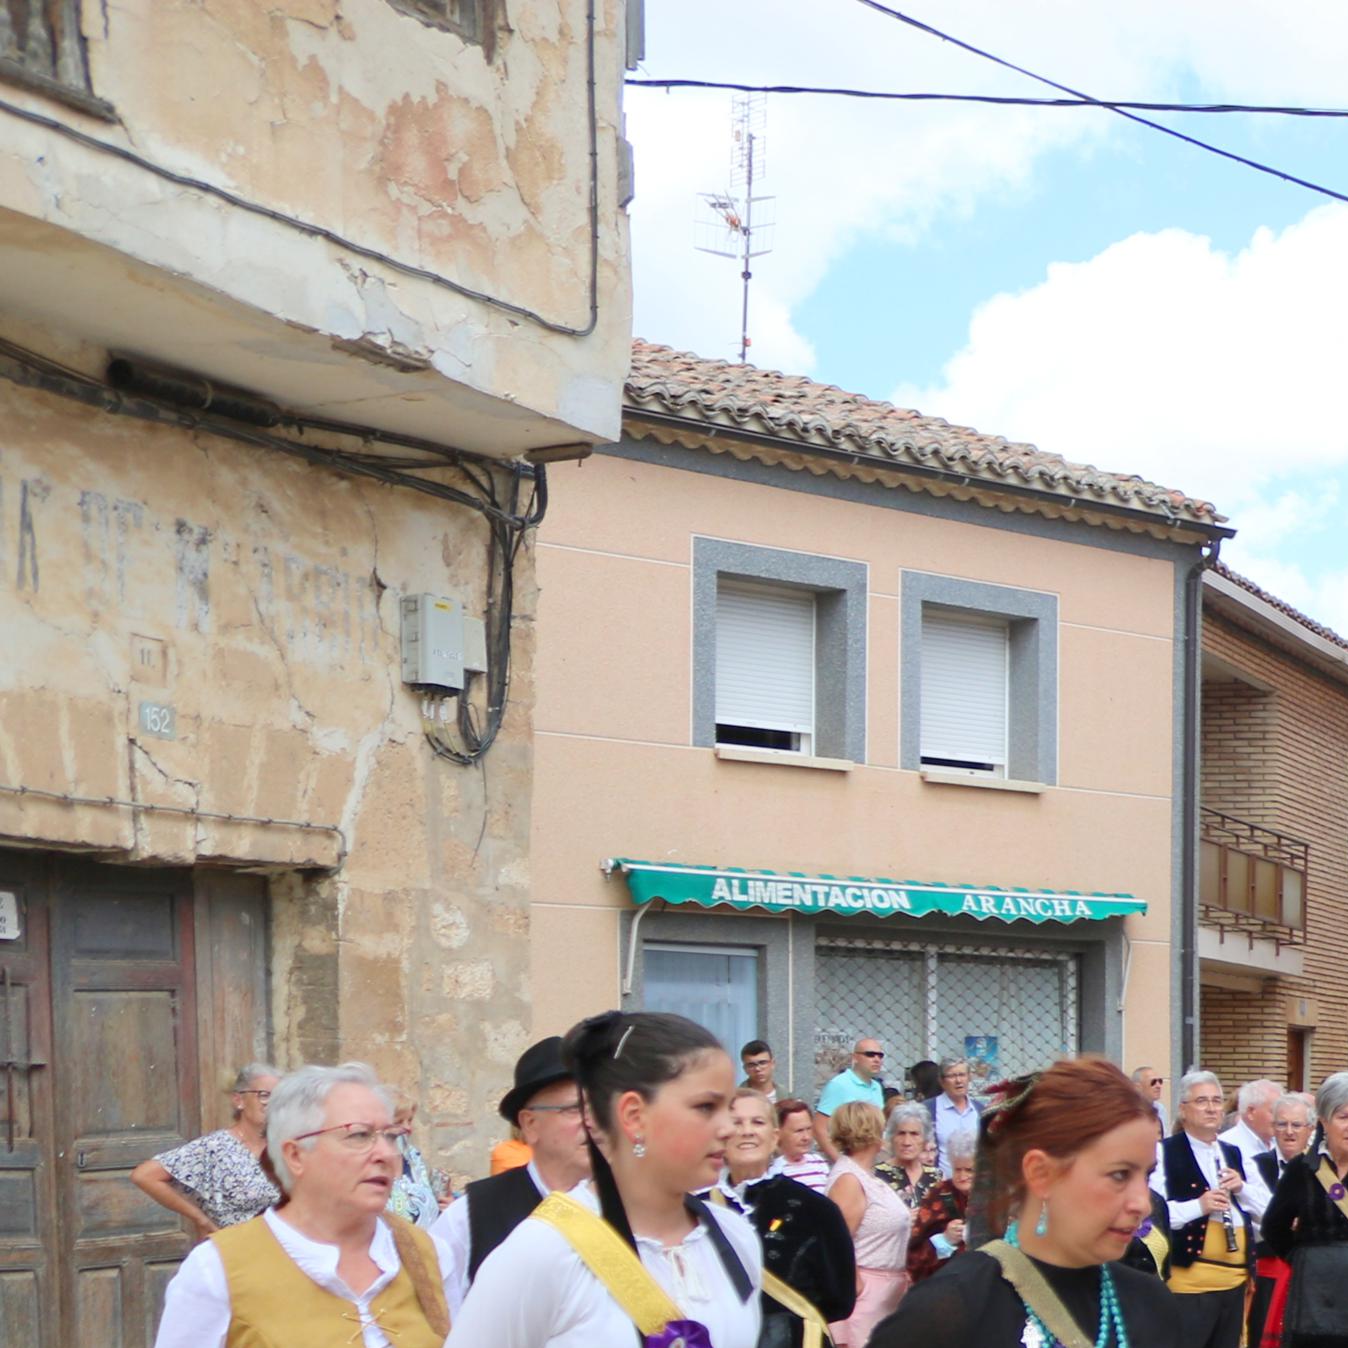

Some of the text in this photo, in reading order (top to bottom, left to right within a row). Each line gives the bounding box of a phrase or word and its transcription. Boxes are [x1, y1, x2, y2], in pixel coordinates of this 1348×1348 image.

[145, 707, 170, 733] 152
[711, 877, 1092, 916] ALIMENTACION ARANCHA
